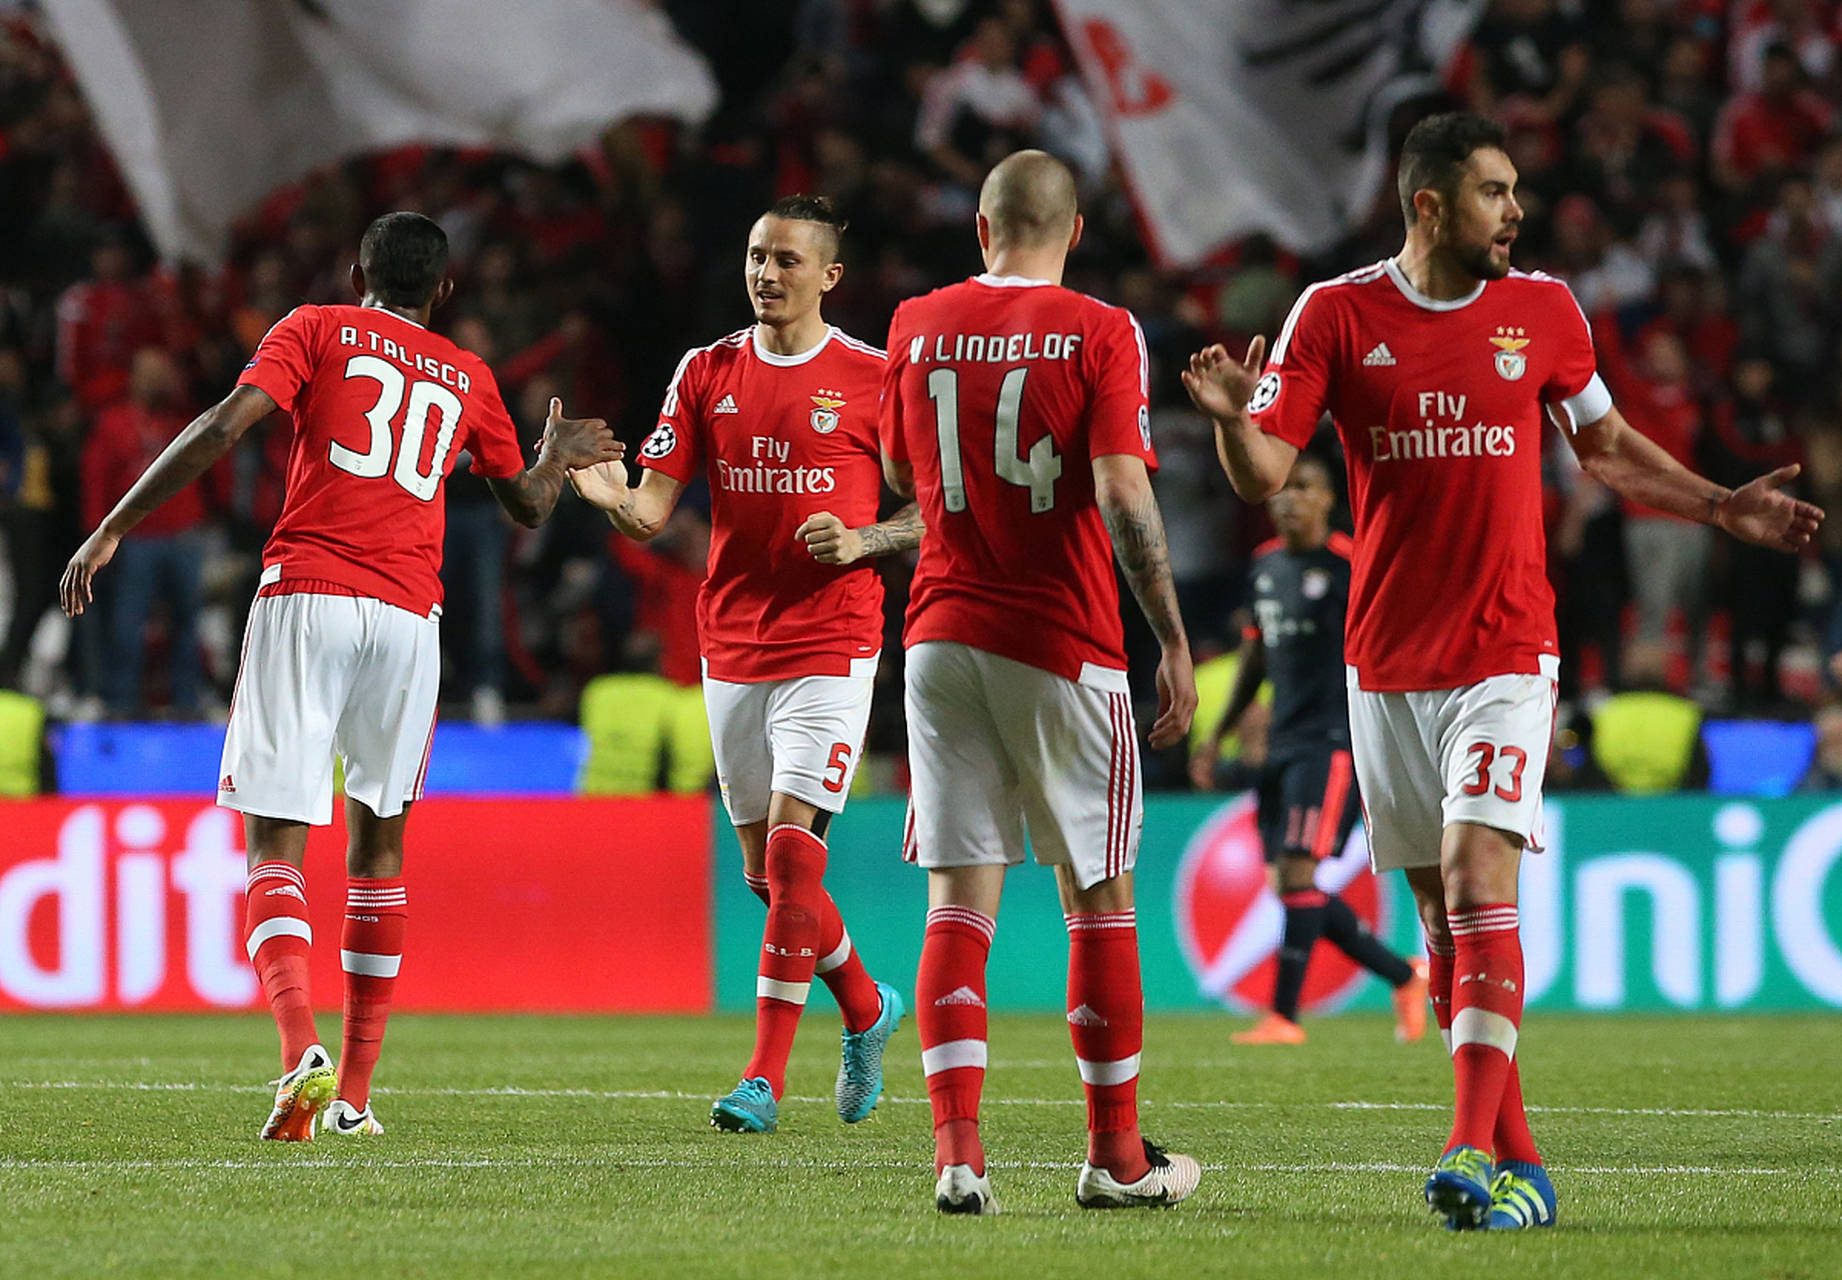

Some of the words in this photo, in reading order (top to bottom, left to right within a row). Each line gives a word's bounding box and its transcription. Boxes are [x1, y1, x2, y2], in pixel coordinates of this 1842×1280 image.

[340, 326, 471, 394] A.TALISCA
[328, 354, 463, 501] 30
[1417, 390, 1467, 421] Fly
[751, 435, 791, 464] Fly
[927, 366, 1062, 514] 14
[1368, 419, 1516, 462] Emirates
[716, 458, 836, 494] Emirates
[822, 742, 852, 793] 5
[1462, 742, 1527, 803] 33
[0, 803, 261, 1008] dit
